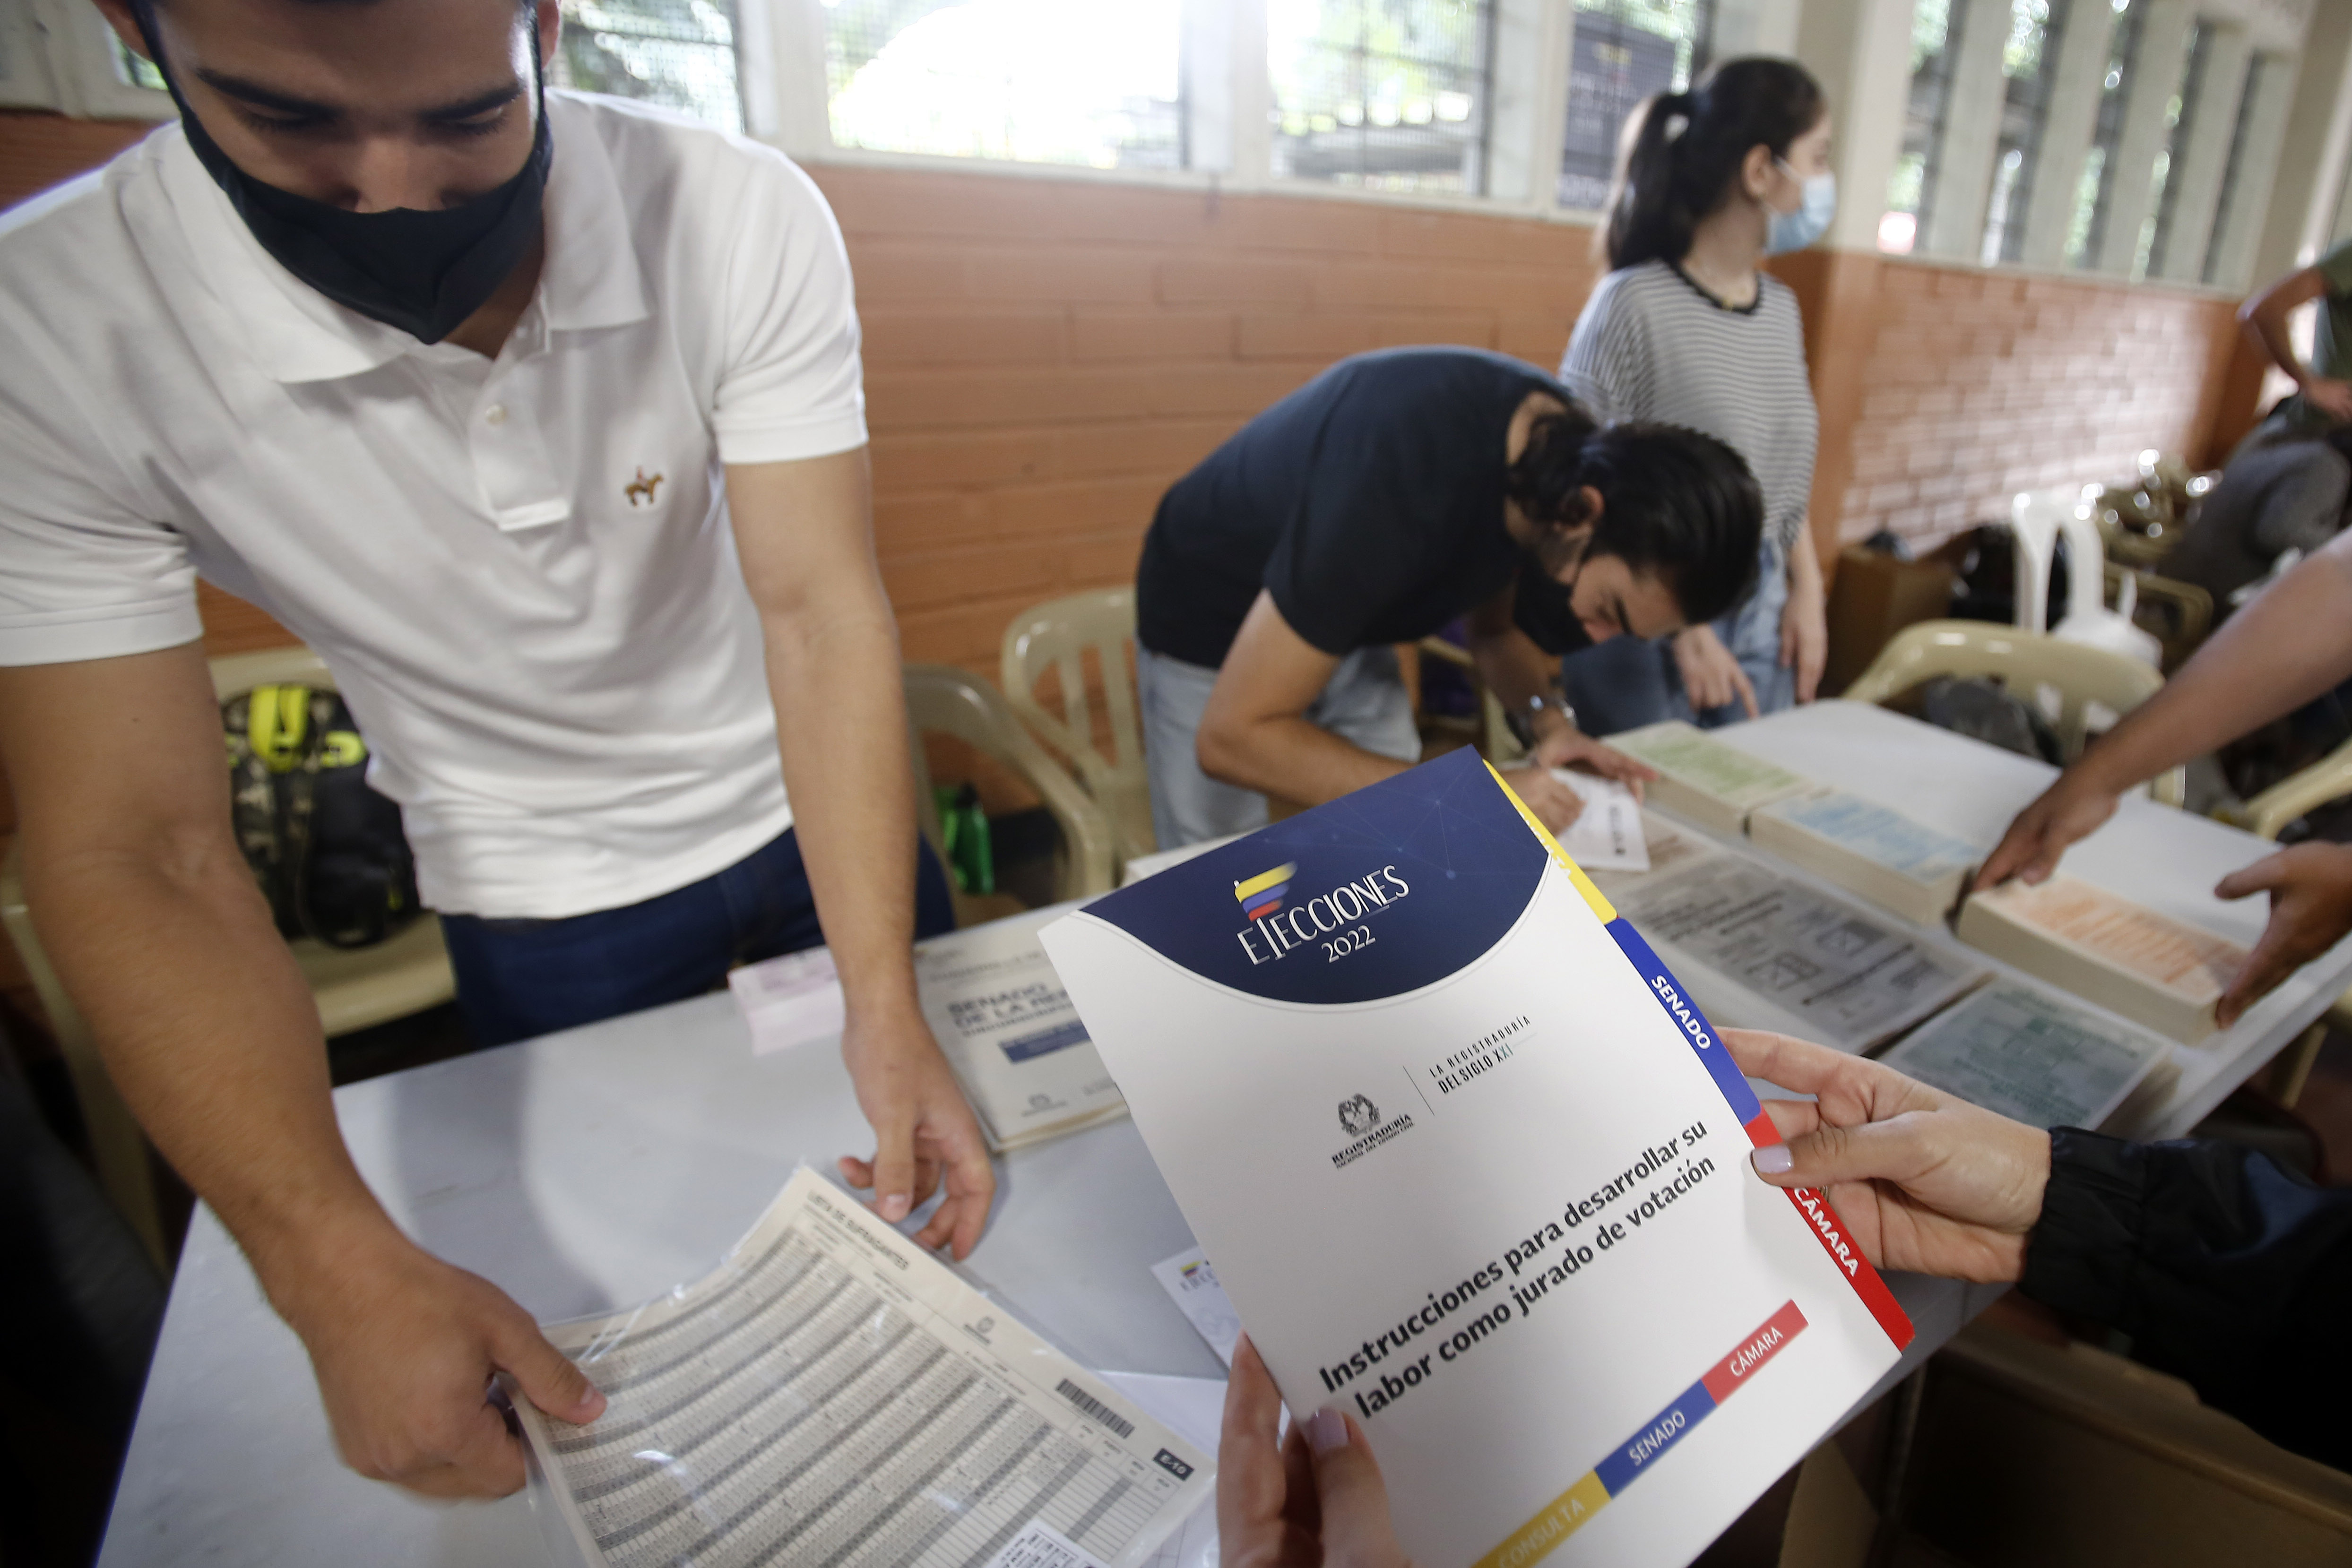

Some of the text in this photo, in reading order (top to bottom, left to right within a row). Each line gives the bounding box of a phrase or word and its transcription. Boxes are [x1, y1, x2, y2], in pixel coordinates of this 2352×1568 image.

[1235, 864, 1410, 965] ELECCIONES
[1321, 925, 1376, 963] 2022
[1651, 974, 1711, 1050] SENADO
[1429, 1015, 1531, 1078] LA REGISTRADURÍA
[1438, 1042, 1514, 1094] DEL SIGLO XXI
[1332, 1113, 1412, 1163] REGISTRADURÍA
[1319, 1120, 1708, 1394] Instrucciones para desarrollar su
[1794, 1188, 1859, 1276] CÁMARA
[1354, 1156, 1716, 1419] labor como jurado de votación
[1730, 1326, 1783, 1377] CÁMARA
[1628, 1410, 1686, 1466] SENADO
